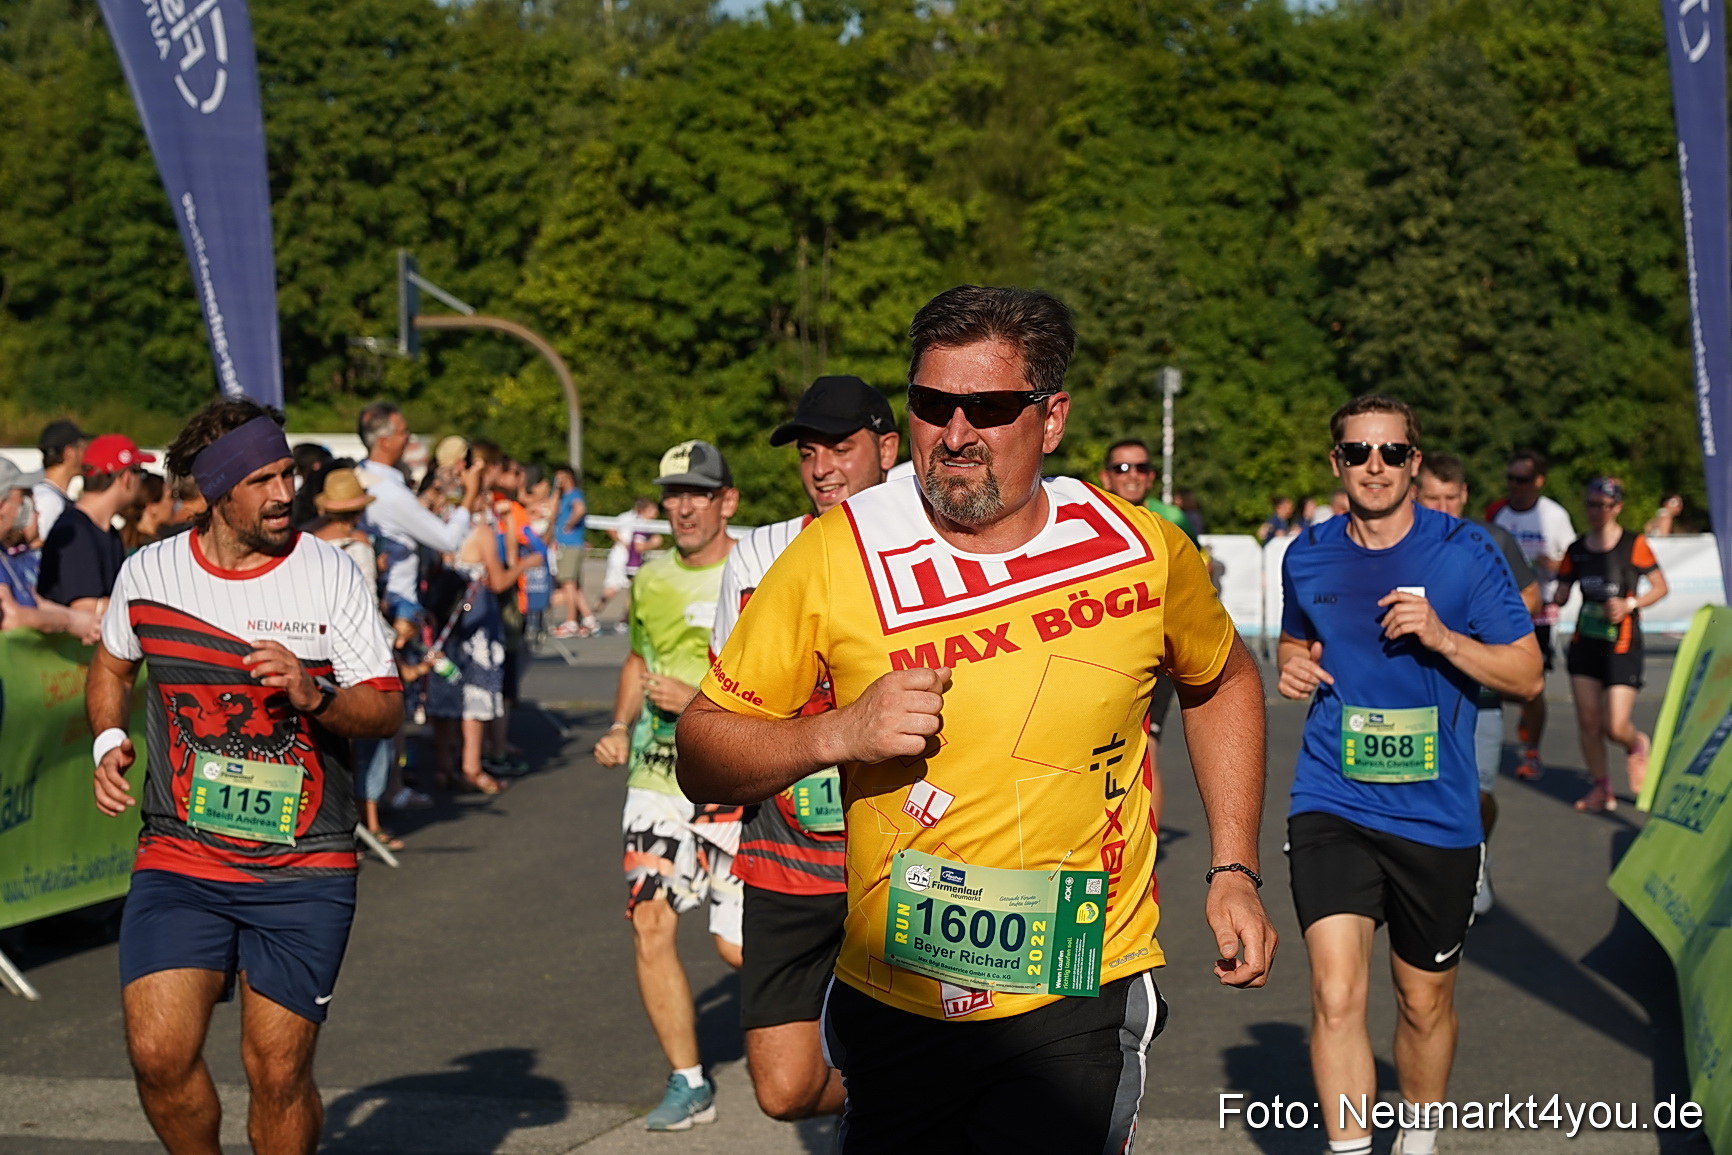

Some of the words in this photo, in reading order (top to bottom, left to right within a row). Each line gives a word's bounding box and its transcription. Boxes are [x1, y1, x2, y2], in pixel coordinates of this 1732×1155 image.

[246, 620, 317, 634] NEUMARKT
[888, 621, 1022, 672] MAX
[1031, 581, 1161, 642] BÖGL
[1364, 735, 1414, 757] 968
[194, 786, 207, 815] RUN
[219, 785, 272, 815] 115
[237, 814, 277, 828] Andreas
[280, 796, 294, 833] 2022
[932, 880, 984, 897] Firmenlauf
[950, 893, 981, 902] neumarkt
[1064, 885, 1073, 902] AOK
[894, 903, 911, 945] RUN
[916, 897, 1026, 952] 1600
[914, 937, 955, 960] Beyer
[959, 949, 1020, 970] Richard
[1027, 920, 1047, 976] 2022
[918, 955, 928, 964] Max
[940, 962, 969, 975] Bauservice
[970, 970, 986, 979] GmbH
[1057, 950, 1065, 971] Laufen
[1055, 971, 1063, 989] Wenn
[1063, 969, 1071, 990] richtig
